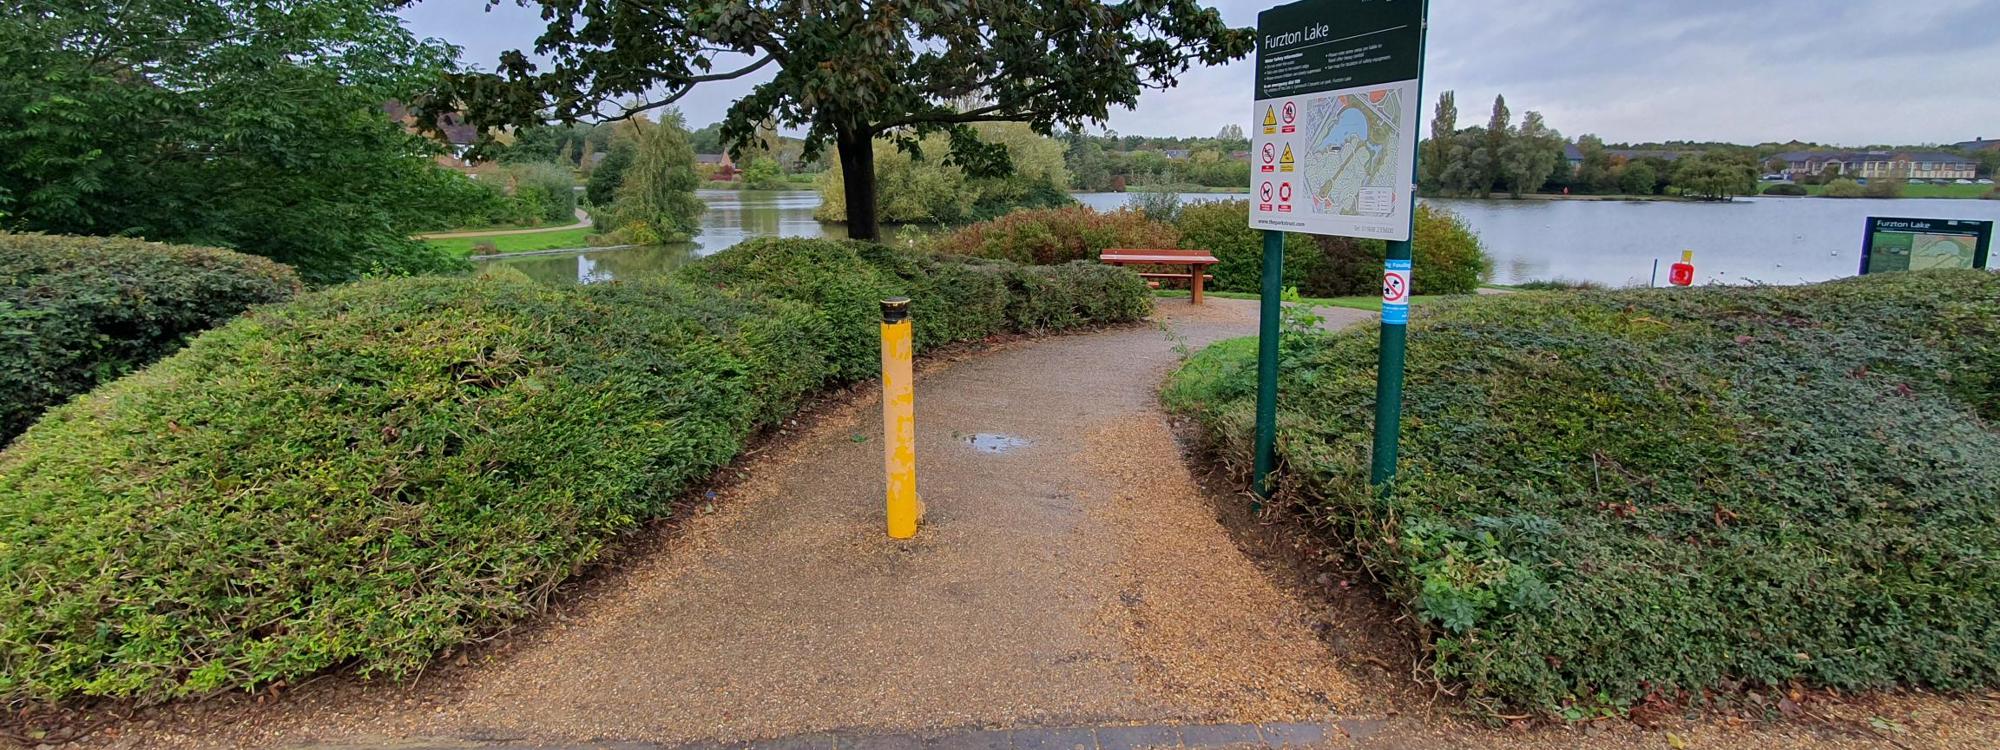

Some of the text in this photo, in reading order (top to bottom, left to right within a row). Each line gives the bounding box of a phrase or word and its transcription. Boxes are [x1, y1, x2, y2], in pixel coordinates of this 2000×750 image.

[1265, 22, 1329, 49] Furzton Lake
[1877, 220, 1931, 229] Furzton Lake
